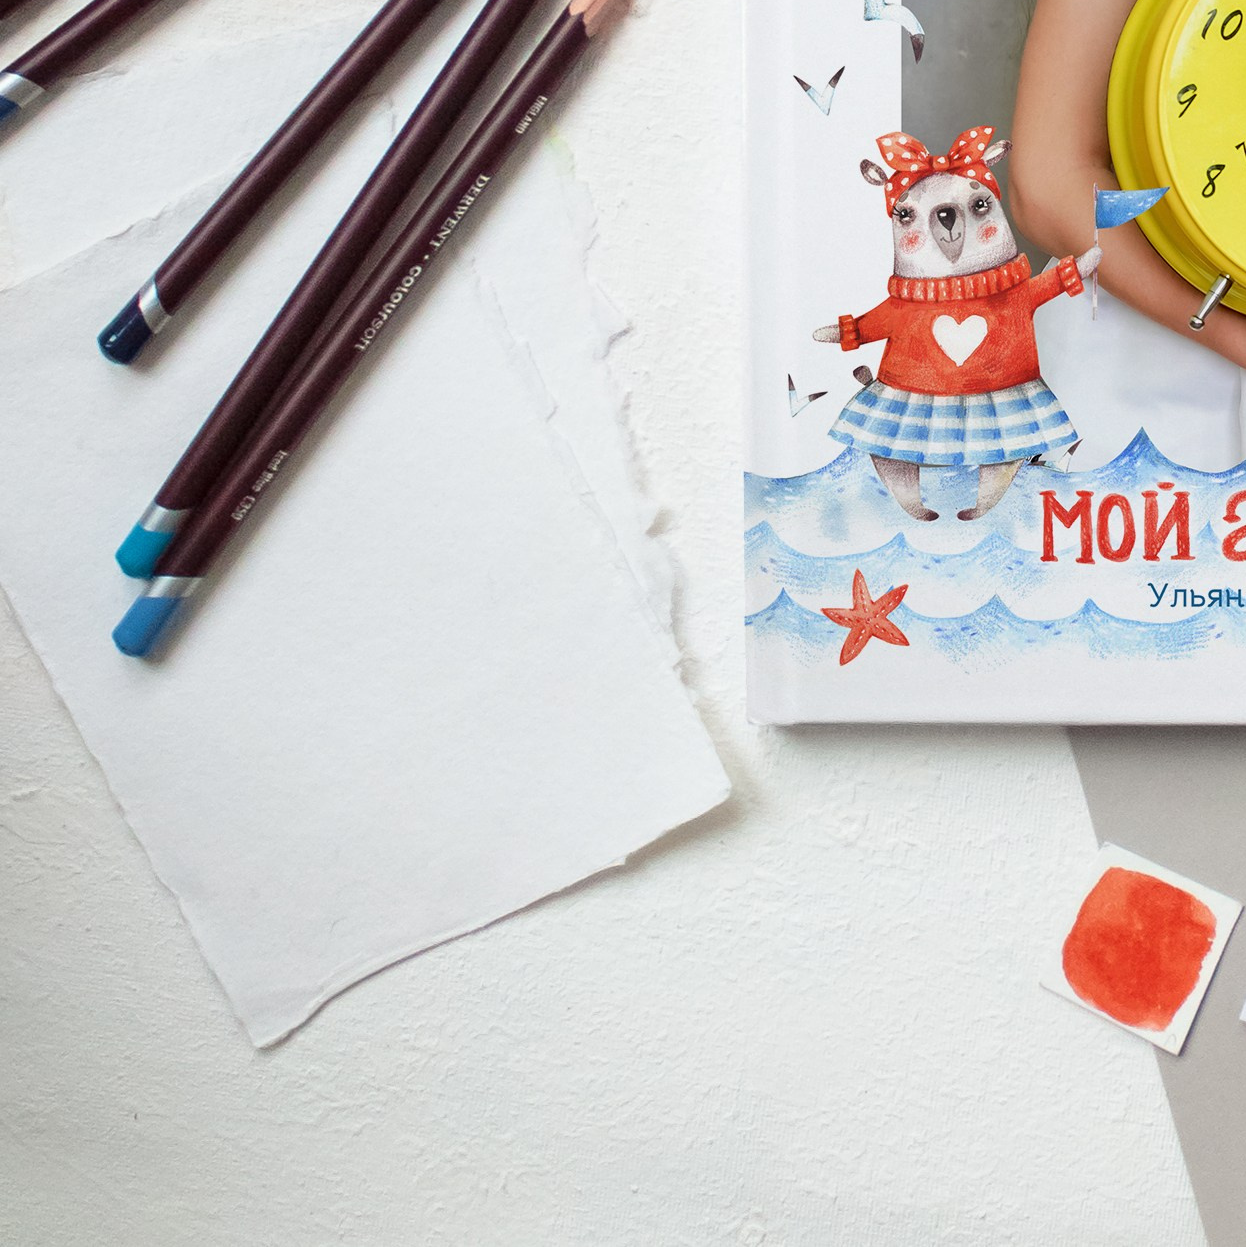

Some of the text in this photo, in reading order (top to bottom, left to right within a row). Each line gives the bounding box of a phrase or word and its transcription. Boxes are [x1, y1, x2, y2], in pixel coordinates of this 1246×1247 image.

[1201, 8, 1243, 41] 10
[514, 95, 548, 134] ENGLAND
[1177, 83, 1198, 118] 9
[1201, 164, 1226, 198] 8
[429, 172, 491, 251] DERWENT
[1039, 481, 1196, 565] МОЙ
